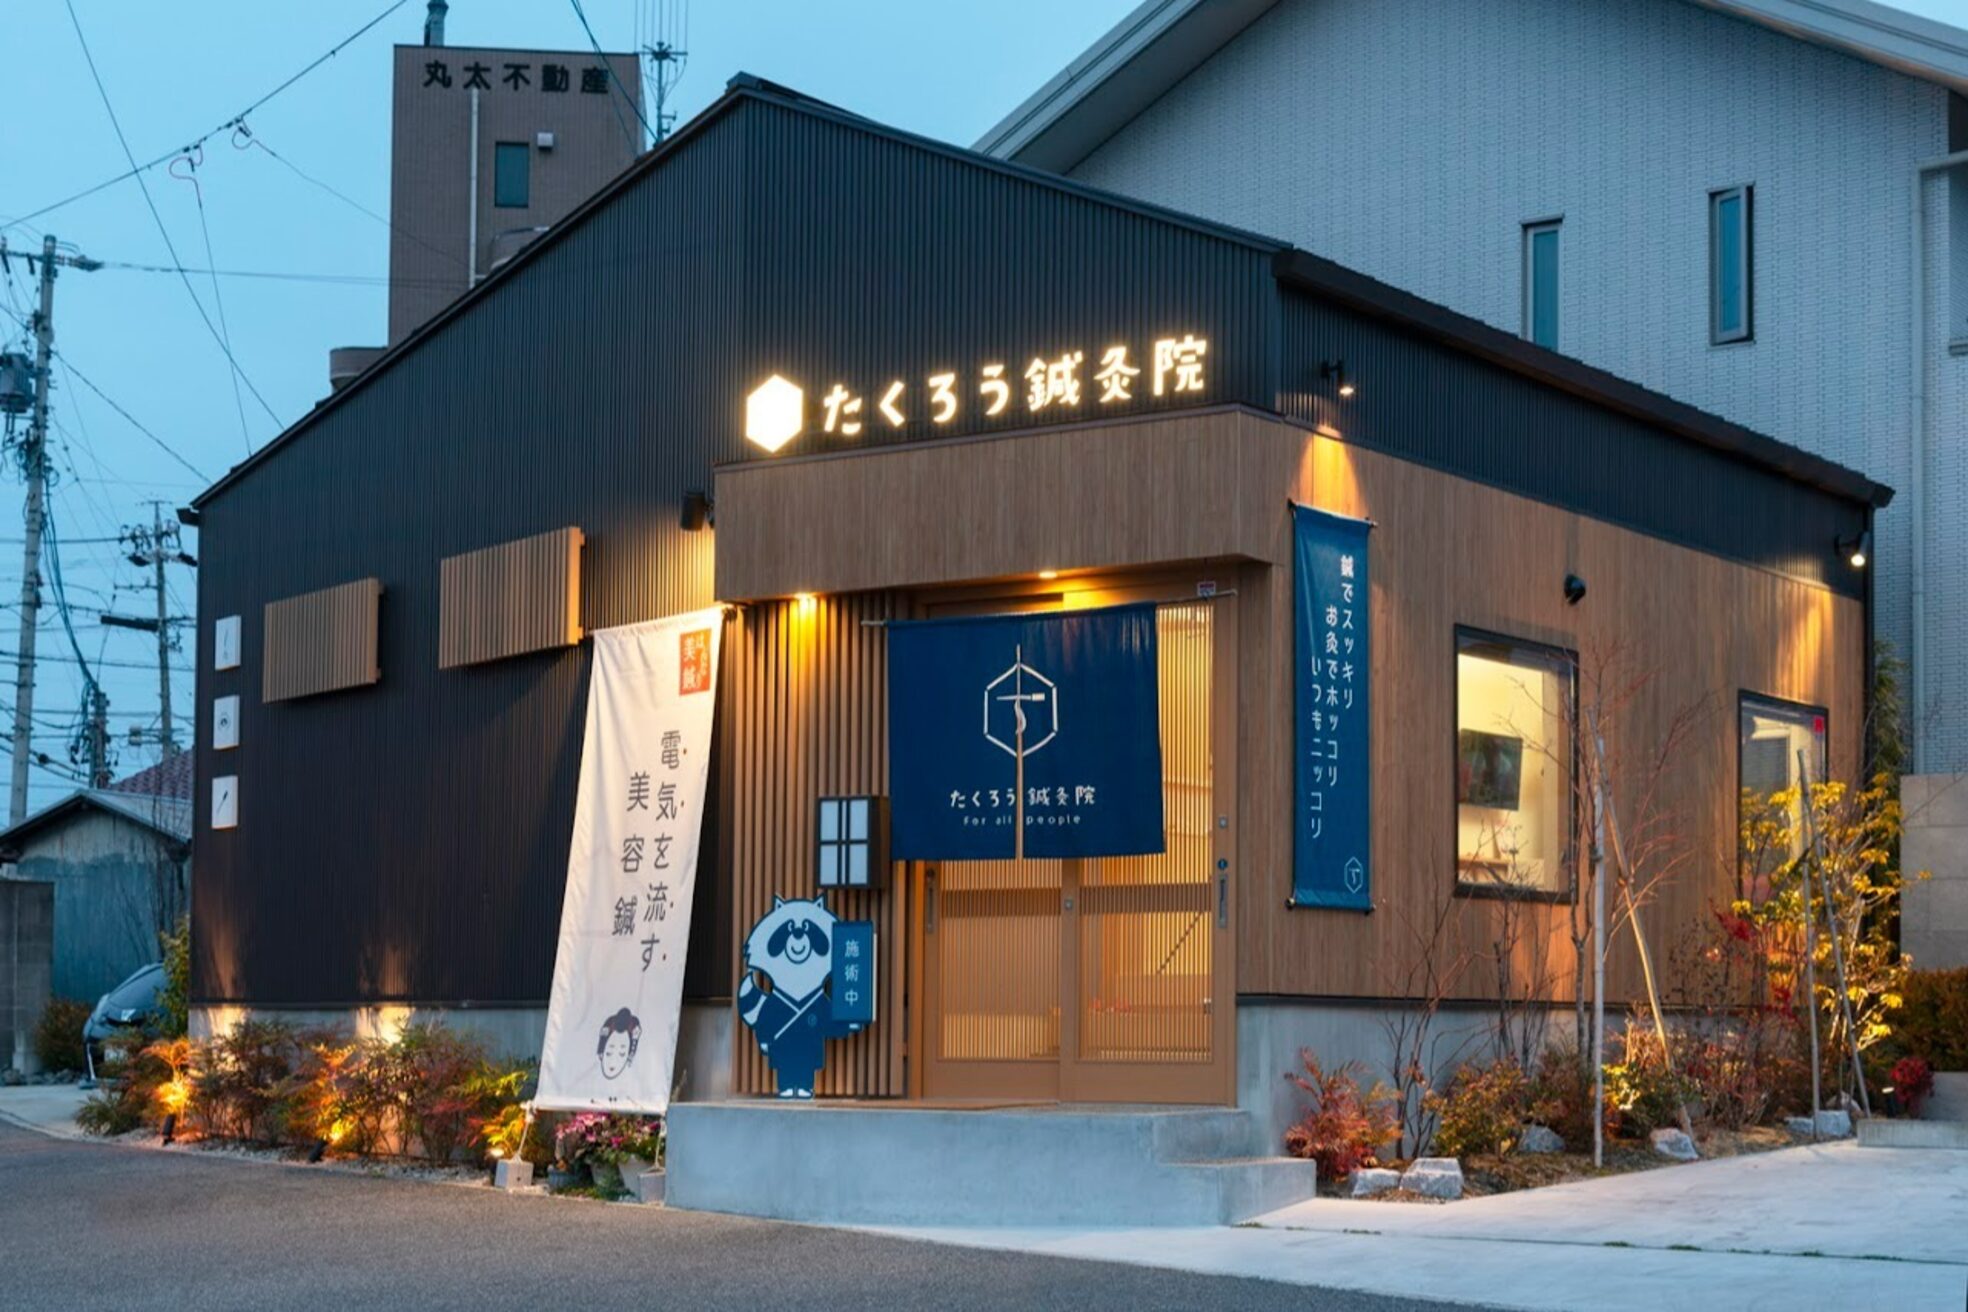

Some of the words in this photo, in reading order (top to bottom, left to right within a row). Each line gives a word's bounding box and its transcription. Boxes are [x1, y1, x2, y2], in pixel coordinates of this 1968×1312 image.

[423, 59, 609, 94] 丸太不動産
[822, 335, 1208, 436] たくろう鍼灸院
[1326, 605, 1339, 786] お灸でホッコリ
[1340, 554, 1354, 709] 鍼でスッキリ
[995, 815, 1012, 825] all
[1026, 814, 1081, 826] people
[1310, 656, 1322, 839] いつもニッコリ
[612, 772, 650, 936] 美容鍼
[641, 730, 681, 971] 電気を流す
[844, 939, 859, 1007] 施術中
